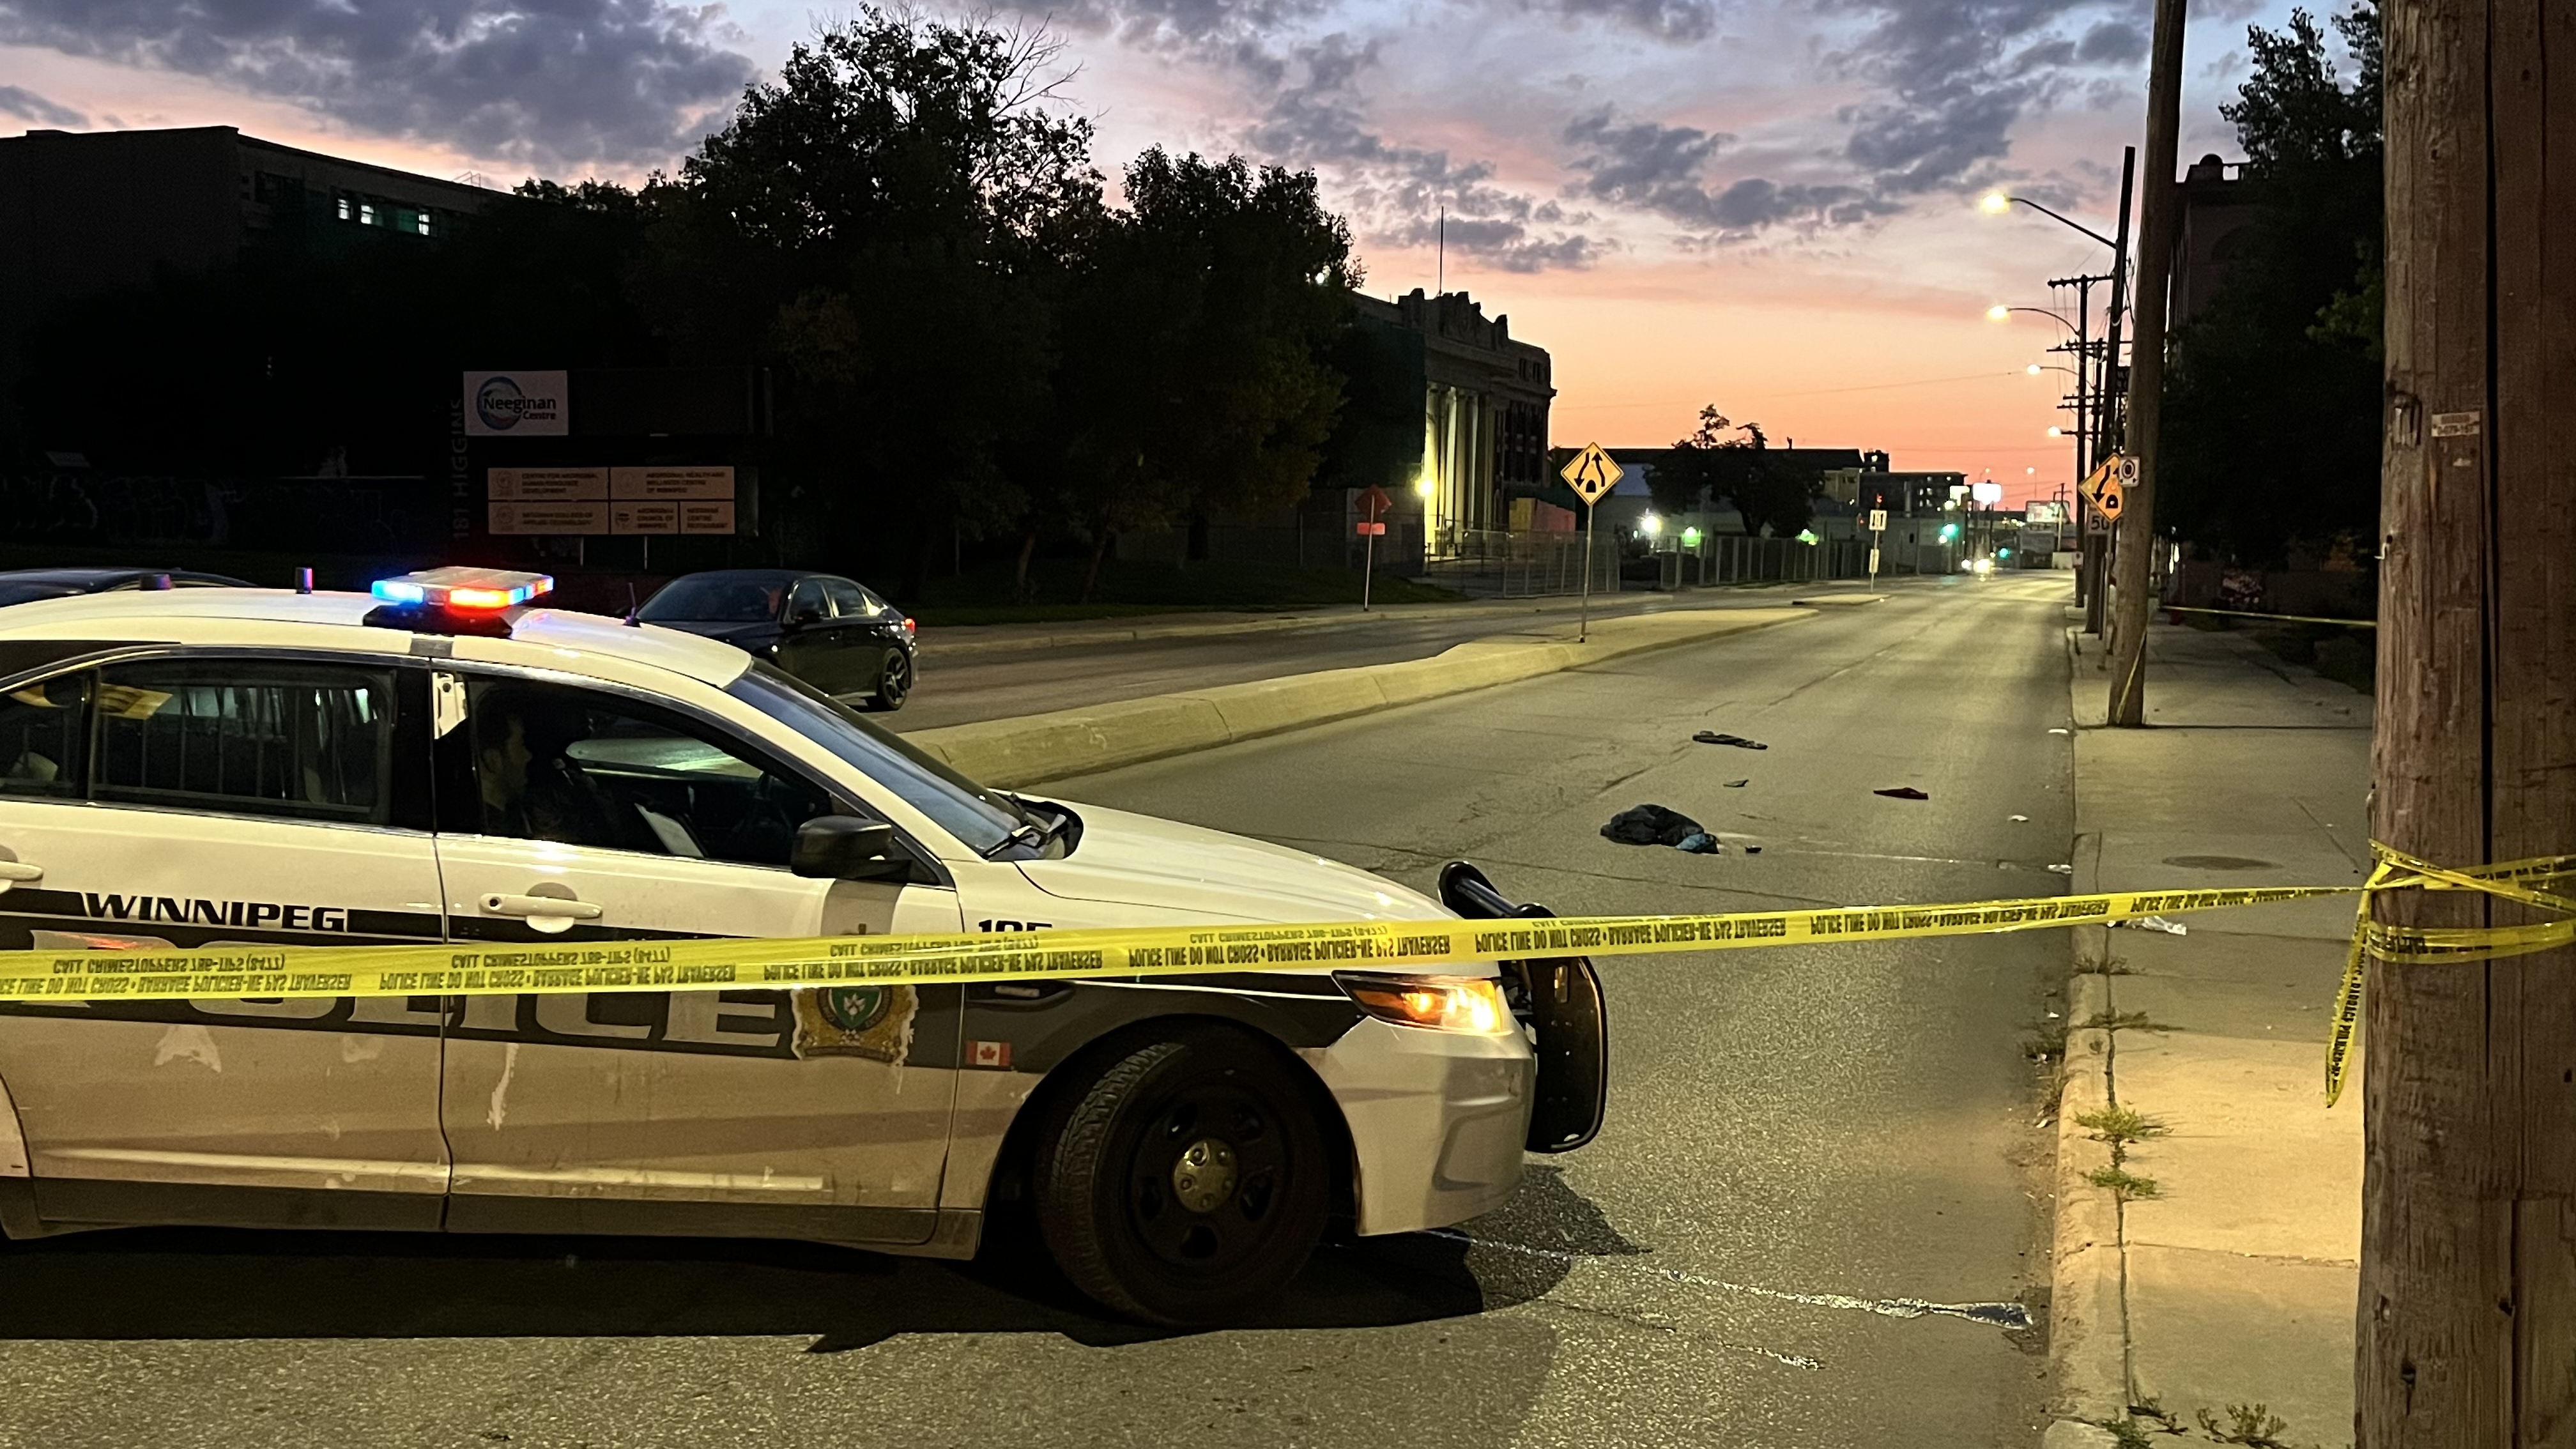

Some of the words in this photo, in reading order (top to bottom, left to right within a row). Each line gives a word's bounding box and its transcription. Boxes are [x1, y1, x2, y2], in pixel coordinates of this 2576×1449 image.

[484, 397, 556, 413] Neeginan
[523, 411, 556, 420] Centre
[85, 893, 345, 932] WINNIPEG
